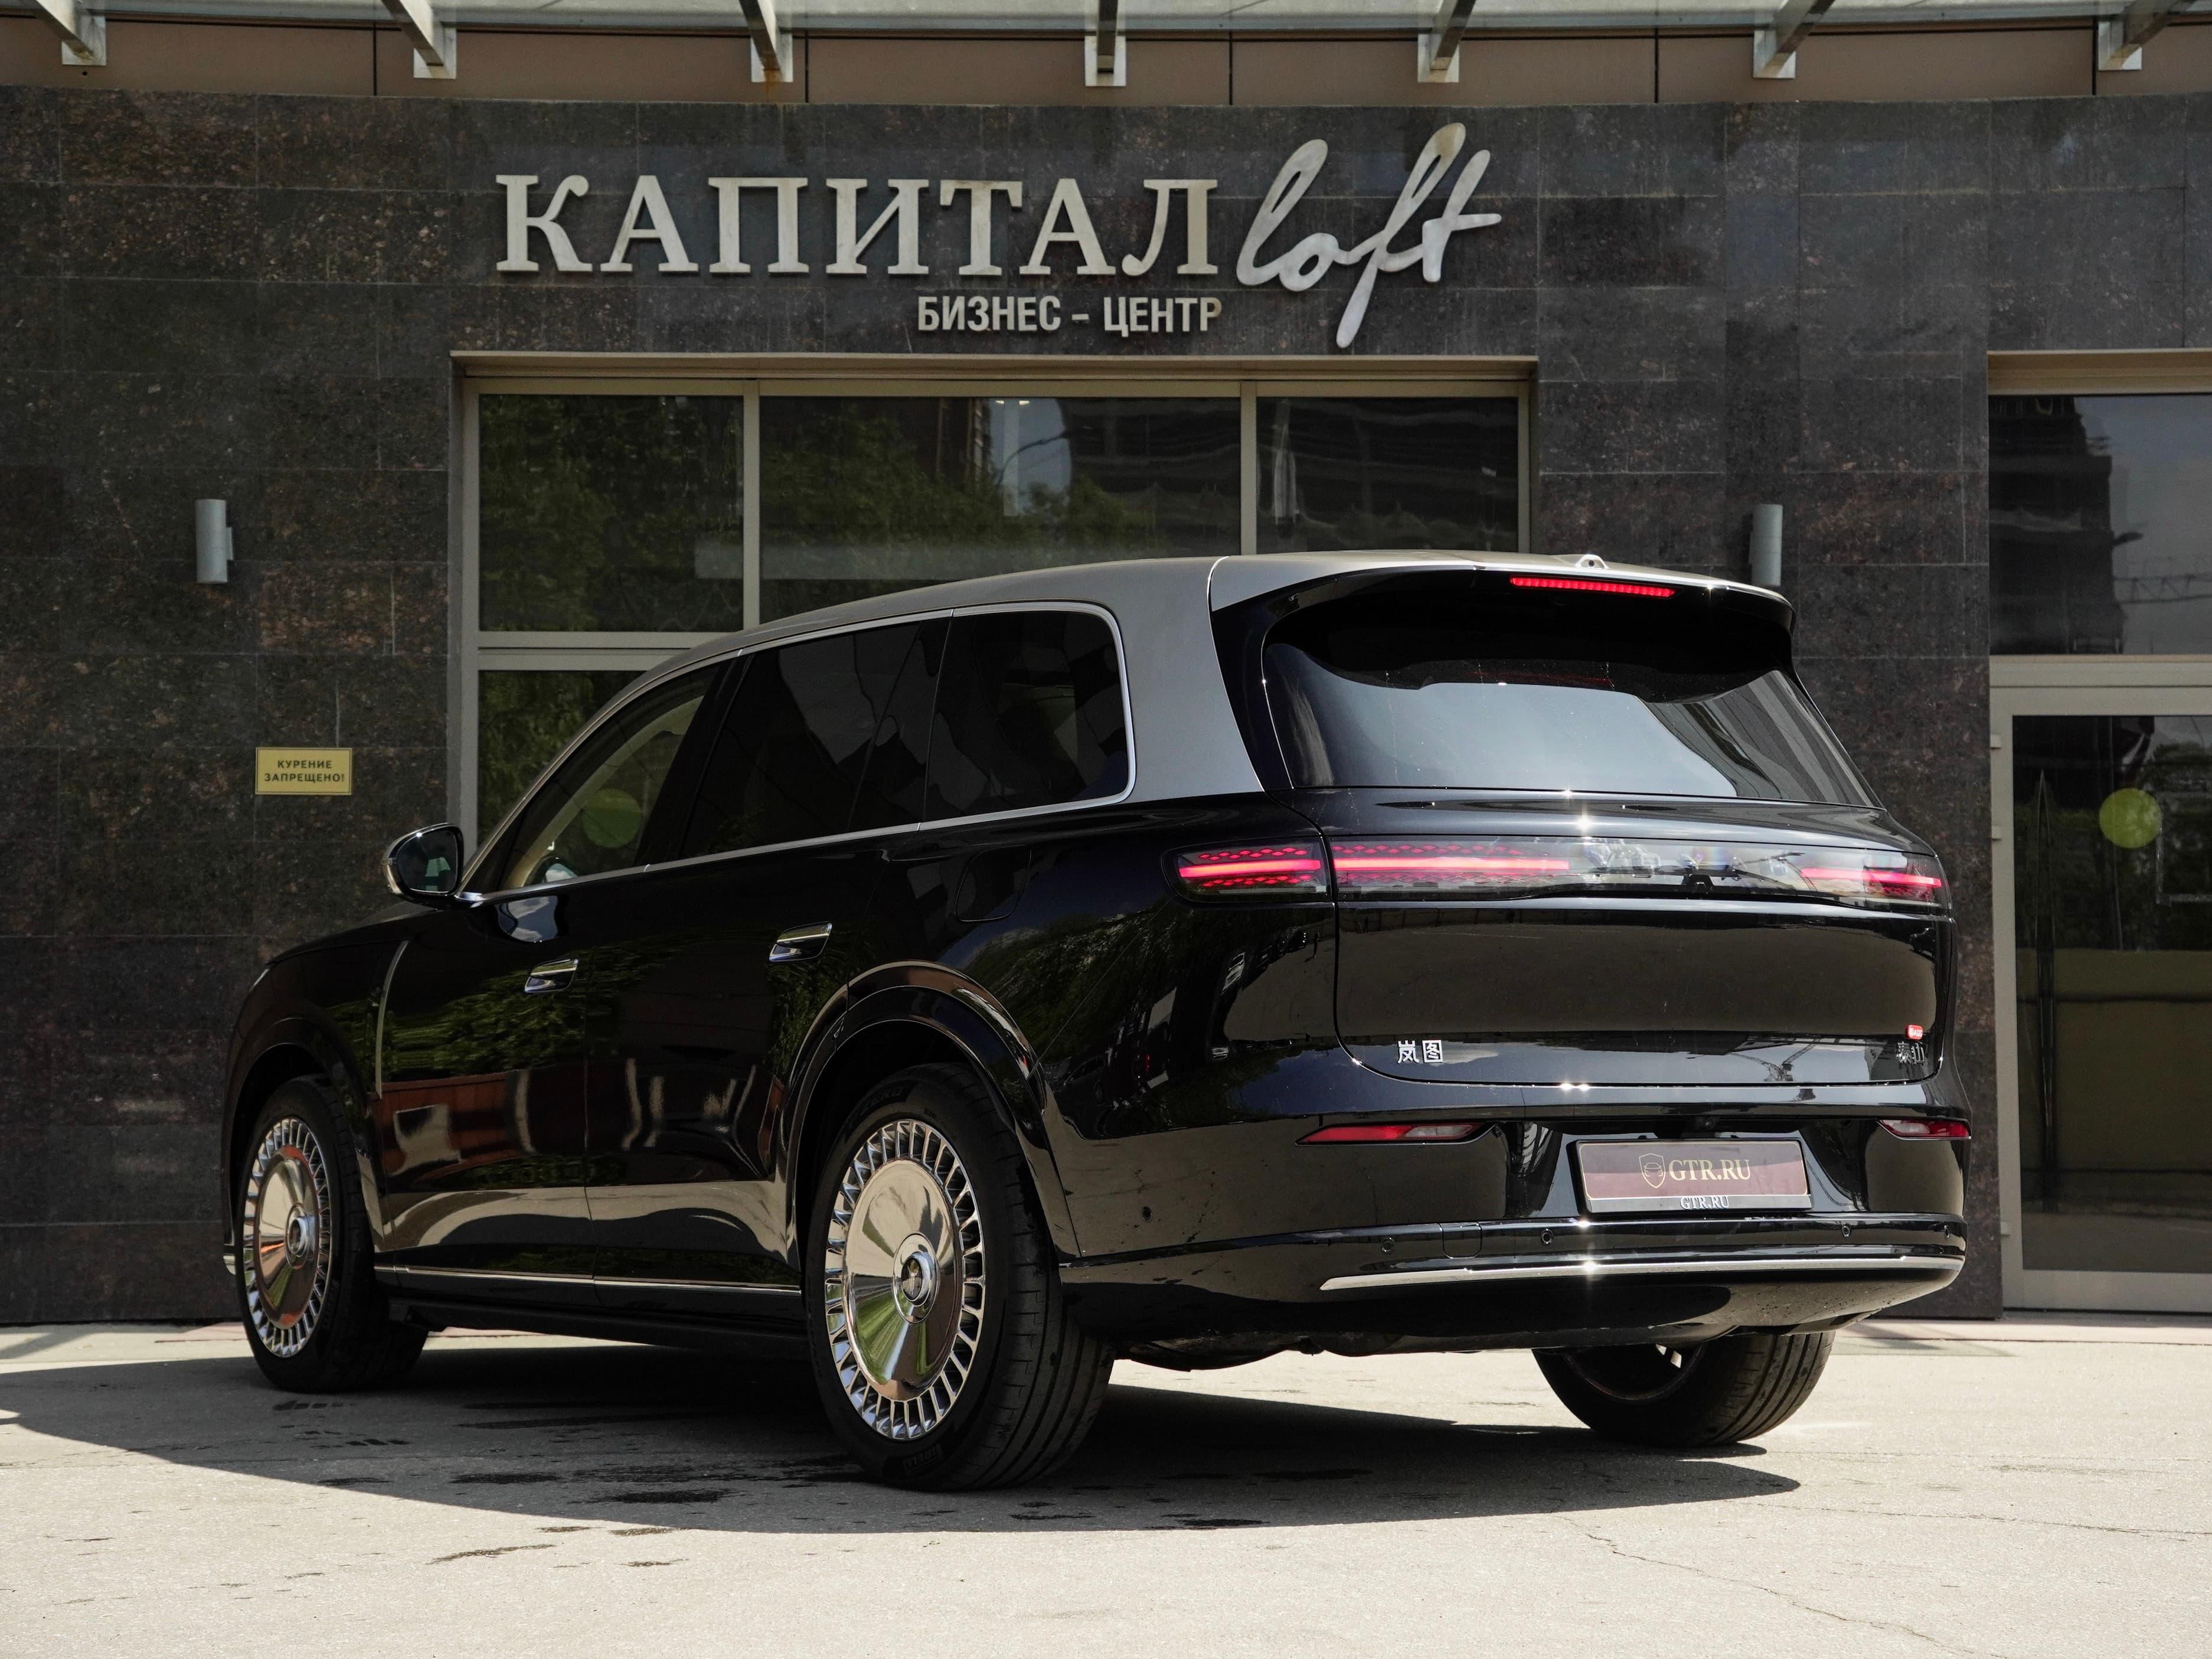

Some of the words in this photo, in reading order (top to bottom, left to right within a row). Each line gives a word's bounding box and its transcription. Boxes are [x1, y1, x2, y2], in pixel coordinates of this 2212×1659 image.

[496, 175, 1218, 276] КАПИТАЛ
[1236, 122, 1502, 348] loft
[917, 296, 1061, 332] БИЗНЕС
[1103, 296, 1222, 338] ЦЕНТР
[277, 760, 332, 769] КУРЕНИЕ
[264, 773, 345, 783] ЗАПРЕЩЕНО!
[1397, 1040, 1443, 1064] 岚图
[1668, 1159, 1751, 1181] GTR.RU
[1680, 1195, 1730, 1210] GTR.RU
